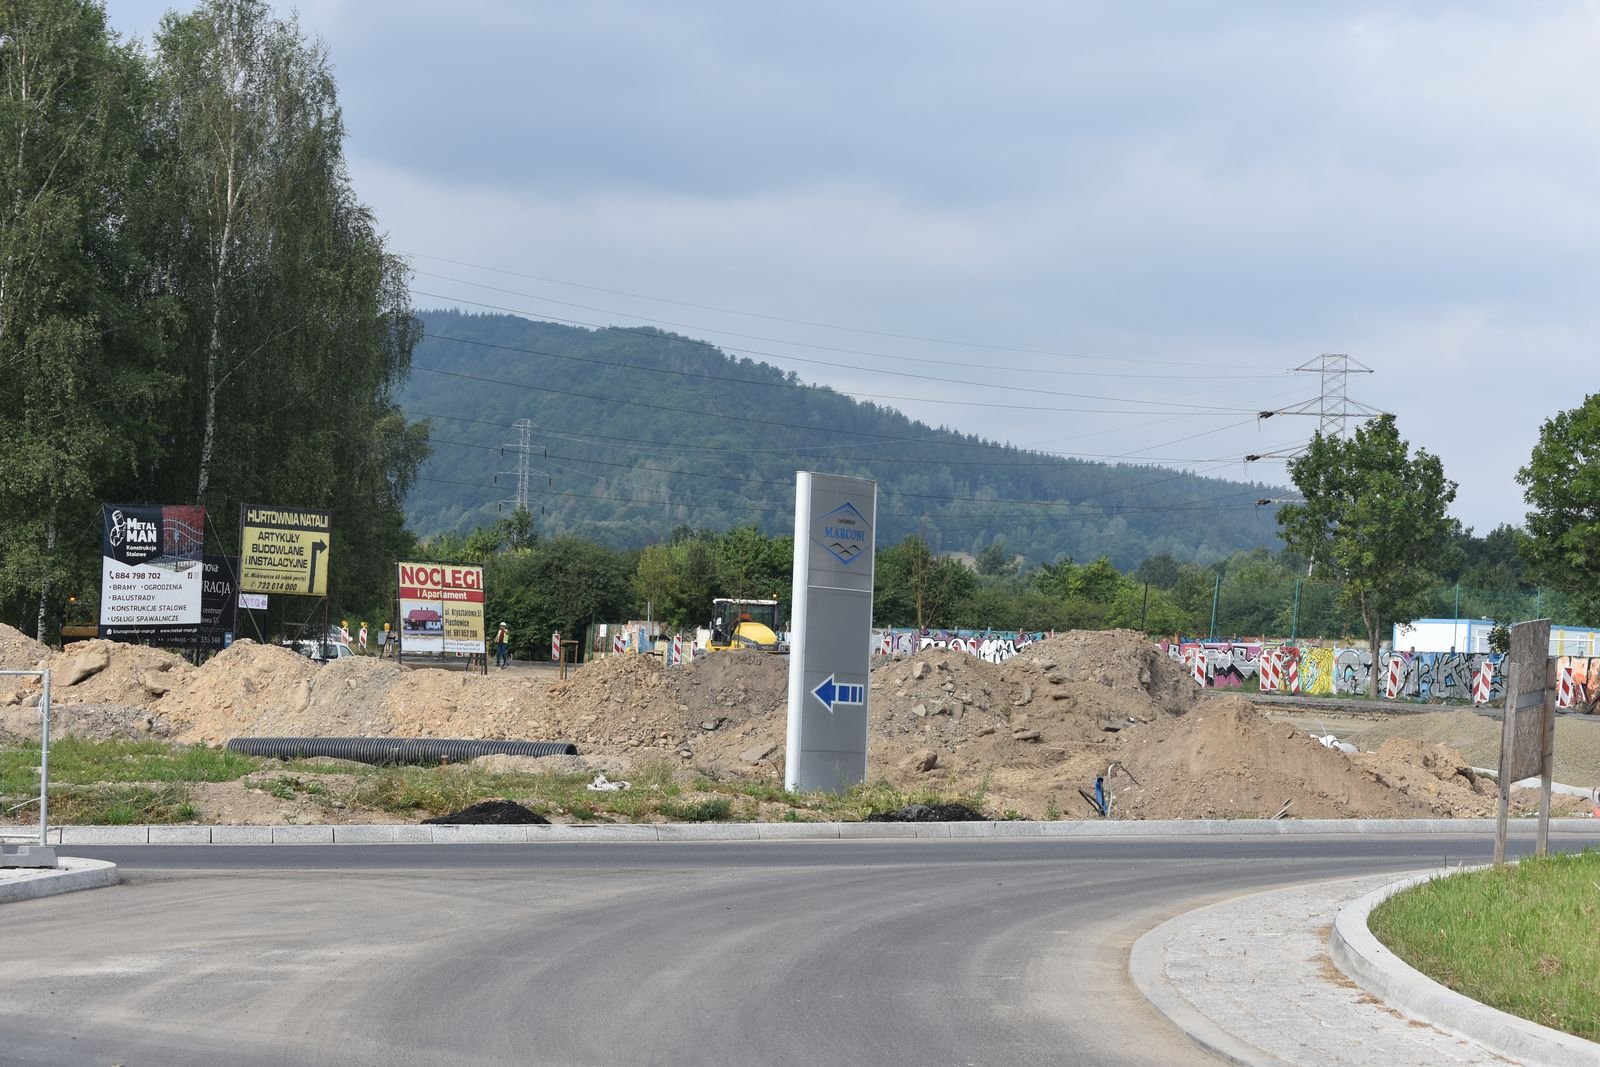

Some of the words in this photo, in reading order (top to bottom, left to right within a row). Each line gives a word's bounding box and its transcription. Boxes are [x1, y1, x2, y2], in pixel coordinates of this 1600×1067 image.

[247, 510, 299, 525] HURTOWNIA
[126, 530, 157, 543] MAN
[258, 531, 301, 544] ARTYKUŁY
[824, 527, 865, 541] MARCONI
[251, 543, 305, 556] BUDOWLANE
[248, 556, 308, 569] INSTALACYJNE
[401, 565, 481, 589] NOCLEGI
[202, 580, 231, 596] RACJA
[257, 581, 271, 590] 722
[271, 582, 284, 590] 014
[285, 583, 298, 591] 000
[422, 589, 468, 600] Apartament
